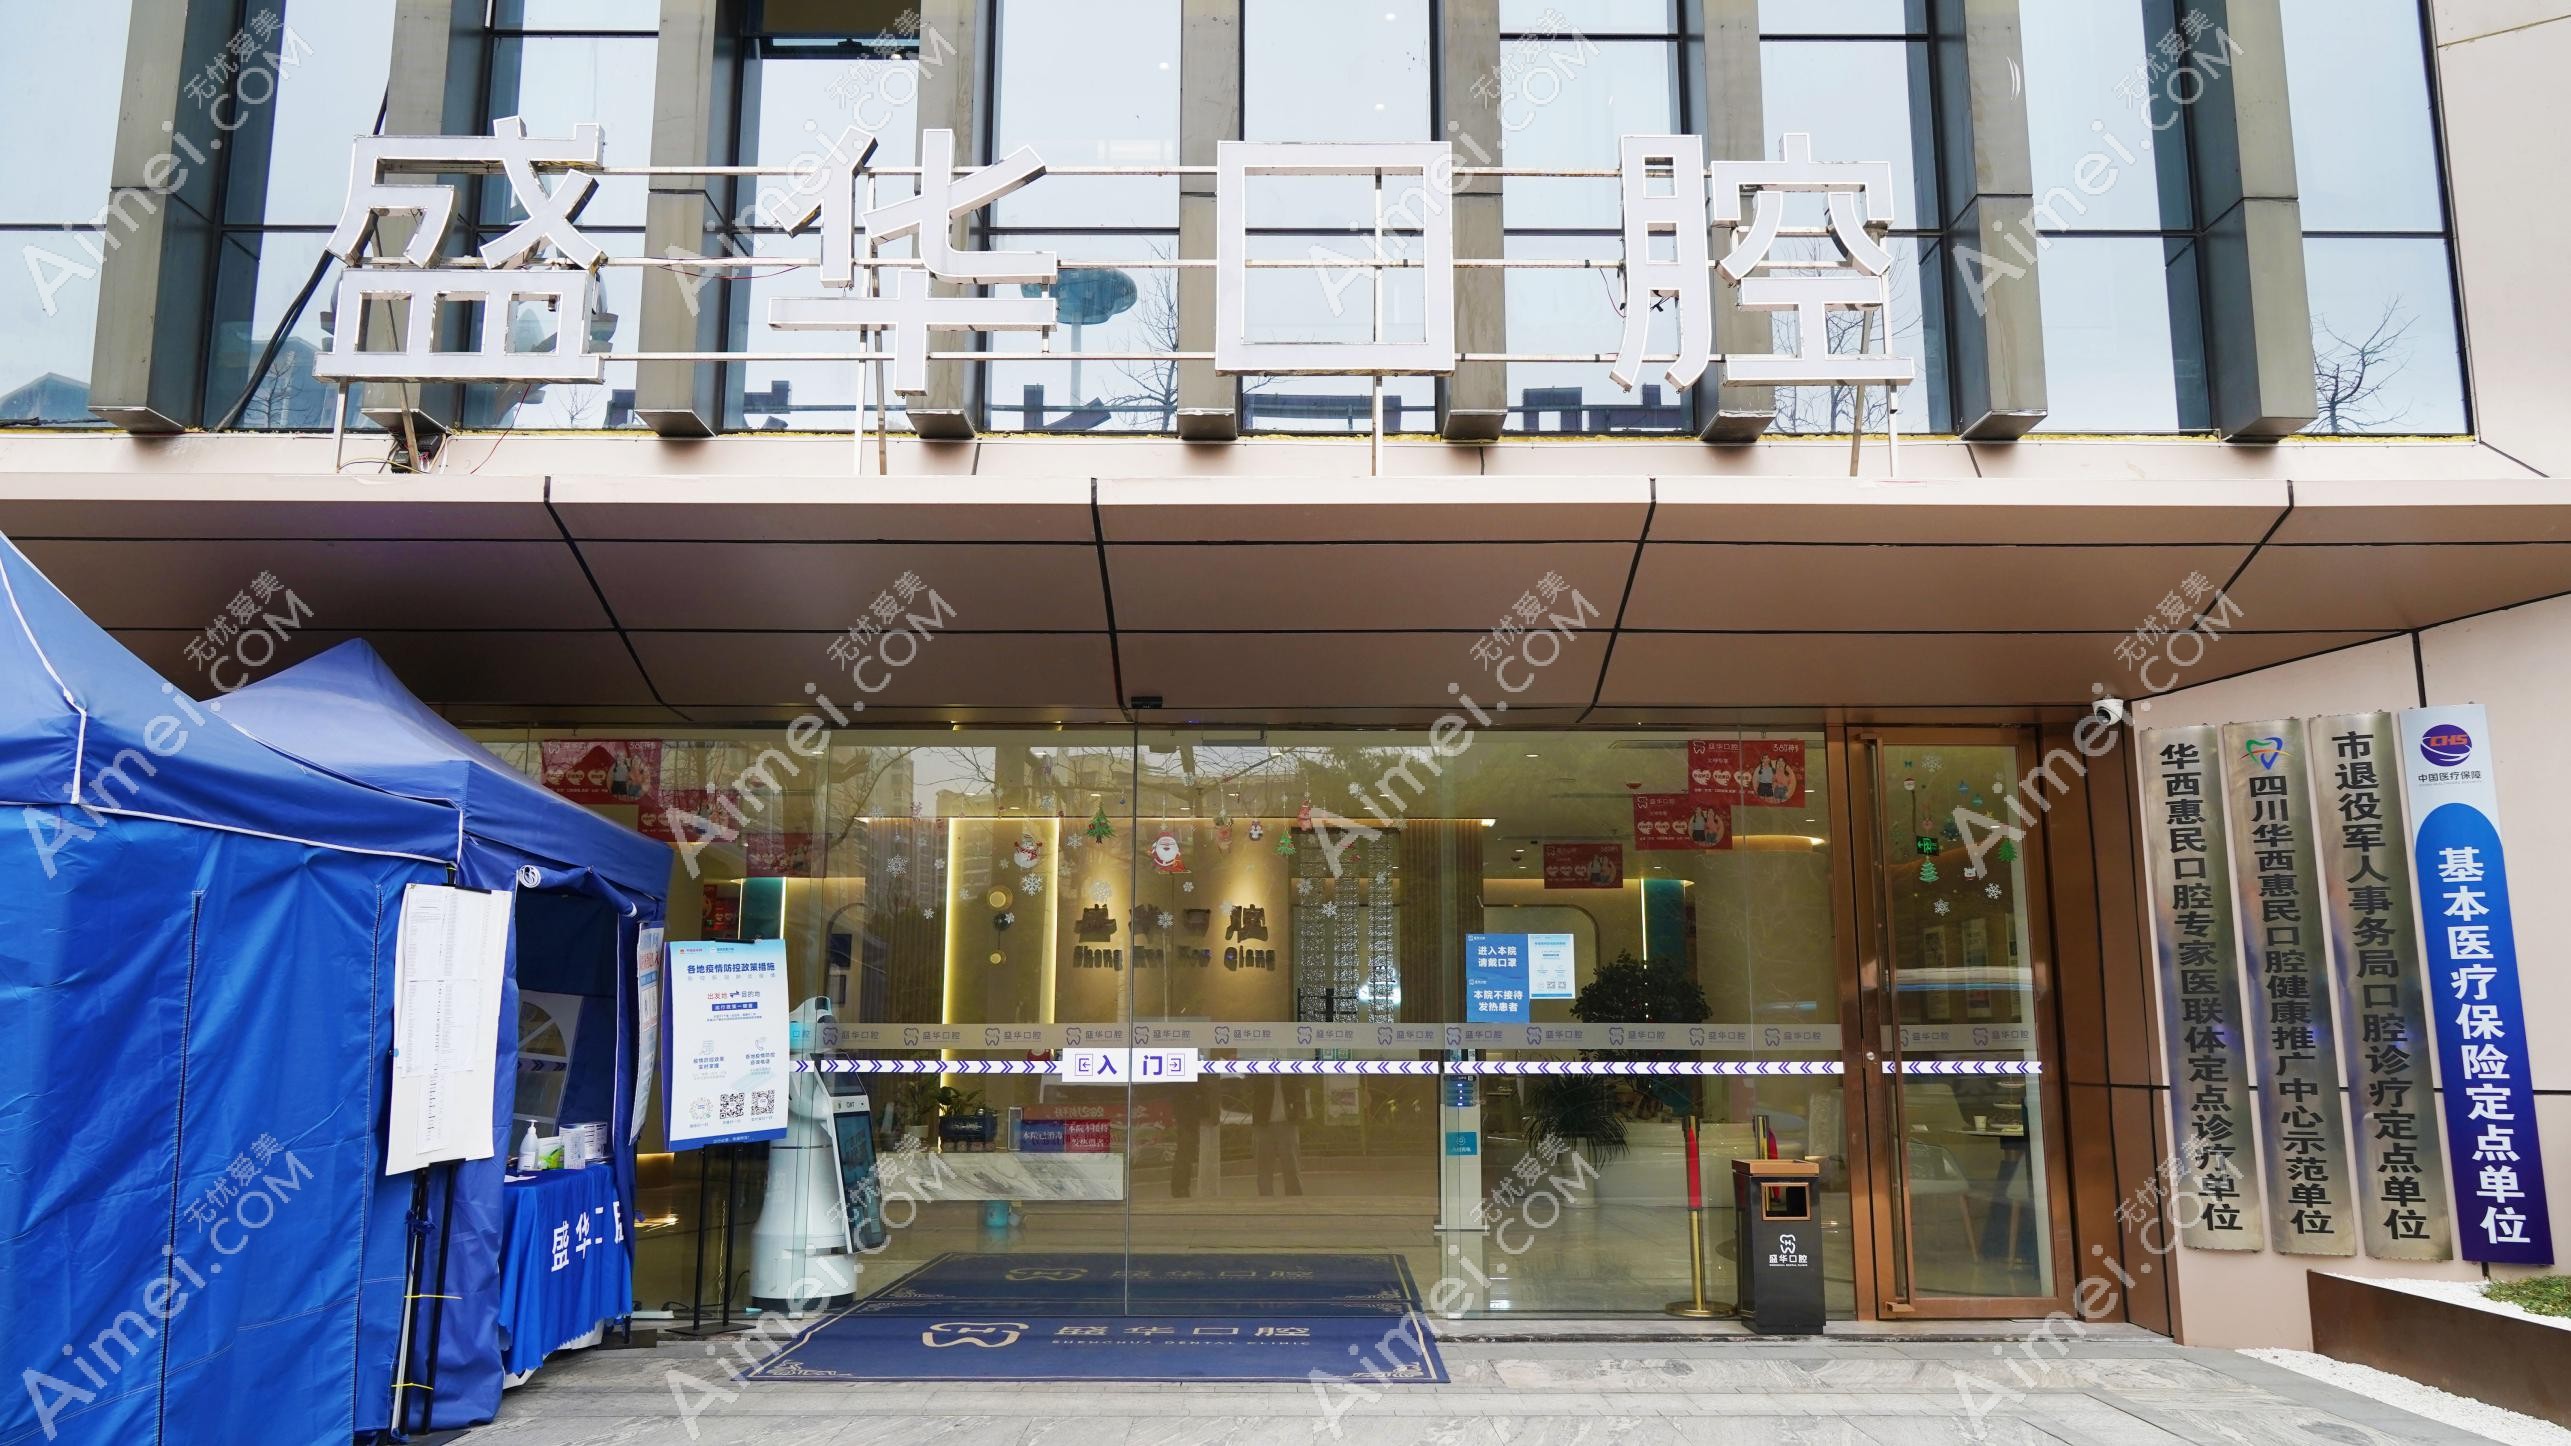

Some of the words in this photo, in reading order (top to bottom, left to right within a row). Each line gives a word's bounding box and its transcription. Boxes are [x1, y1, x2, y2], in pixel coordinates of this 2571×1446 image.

[314, 115, 1916, 396] 盛华口腔
[2429, 734, 2468, 747] CHS
[2418, 770, 2482, 783] 中国医疗保障
[1478, 945, 1517, 956] 进入本院
[687, 962, 776, 974] 各地疫情防控政策措施
[1478, 957, 1518, 968] 请戴口罩
[2158, 742, 2243, 1231] 华西惠民口腔专家医联体定点诊疗单位
[2331, 730, 2431, 1240] 市退役军人事务局口腔诊疗定点单位
[1473, 990, 1523, 1000] 本院不接待
[1478, 1002, 1518, 1012] 发热患者
[2248, 774, 2334, 1235] 四川华西惠民口腔健康推广中心示范单位
[2438, 845, 2532, 1245] 基本医疗保险定点单位
[1097, 1055, 1118, 1075] 入
[1142, 1055, 1163, 1076] 门
[1769, 1254, 1808, 1263] 盛华口腔
[1055, 1326, 1312, 1337] 盛华口腔
